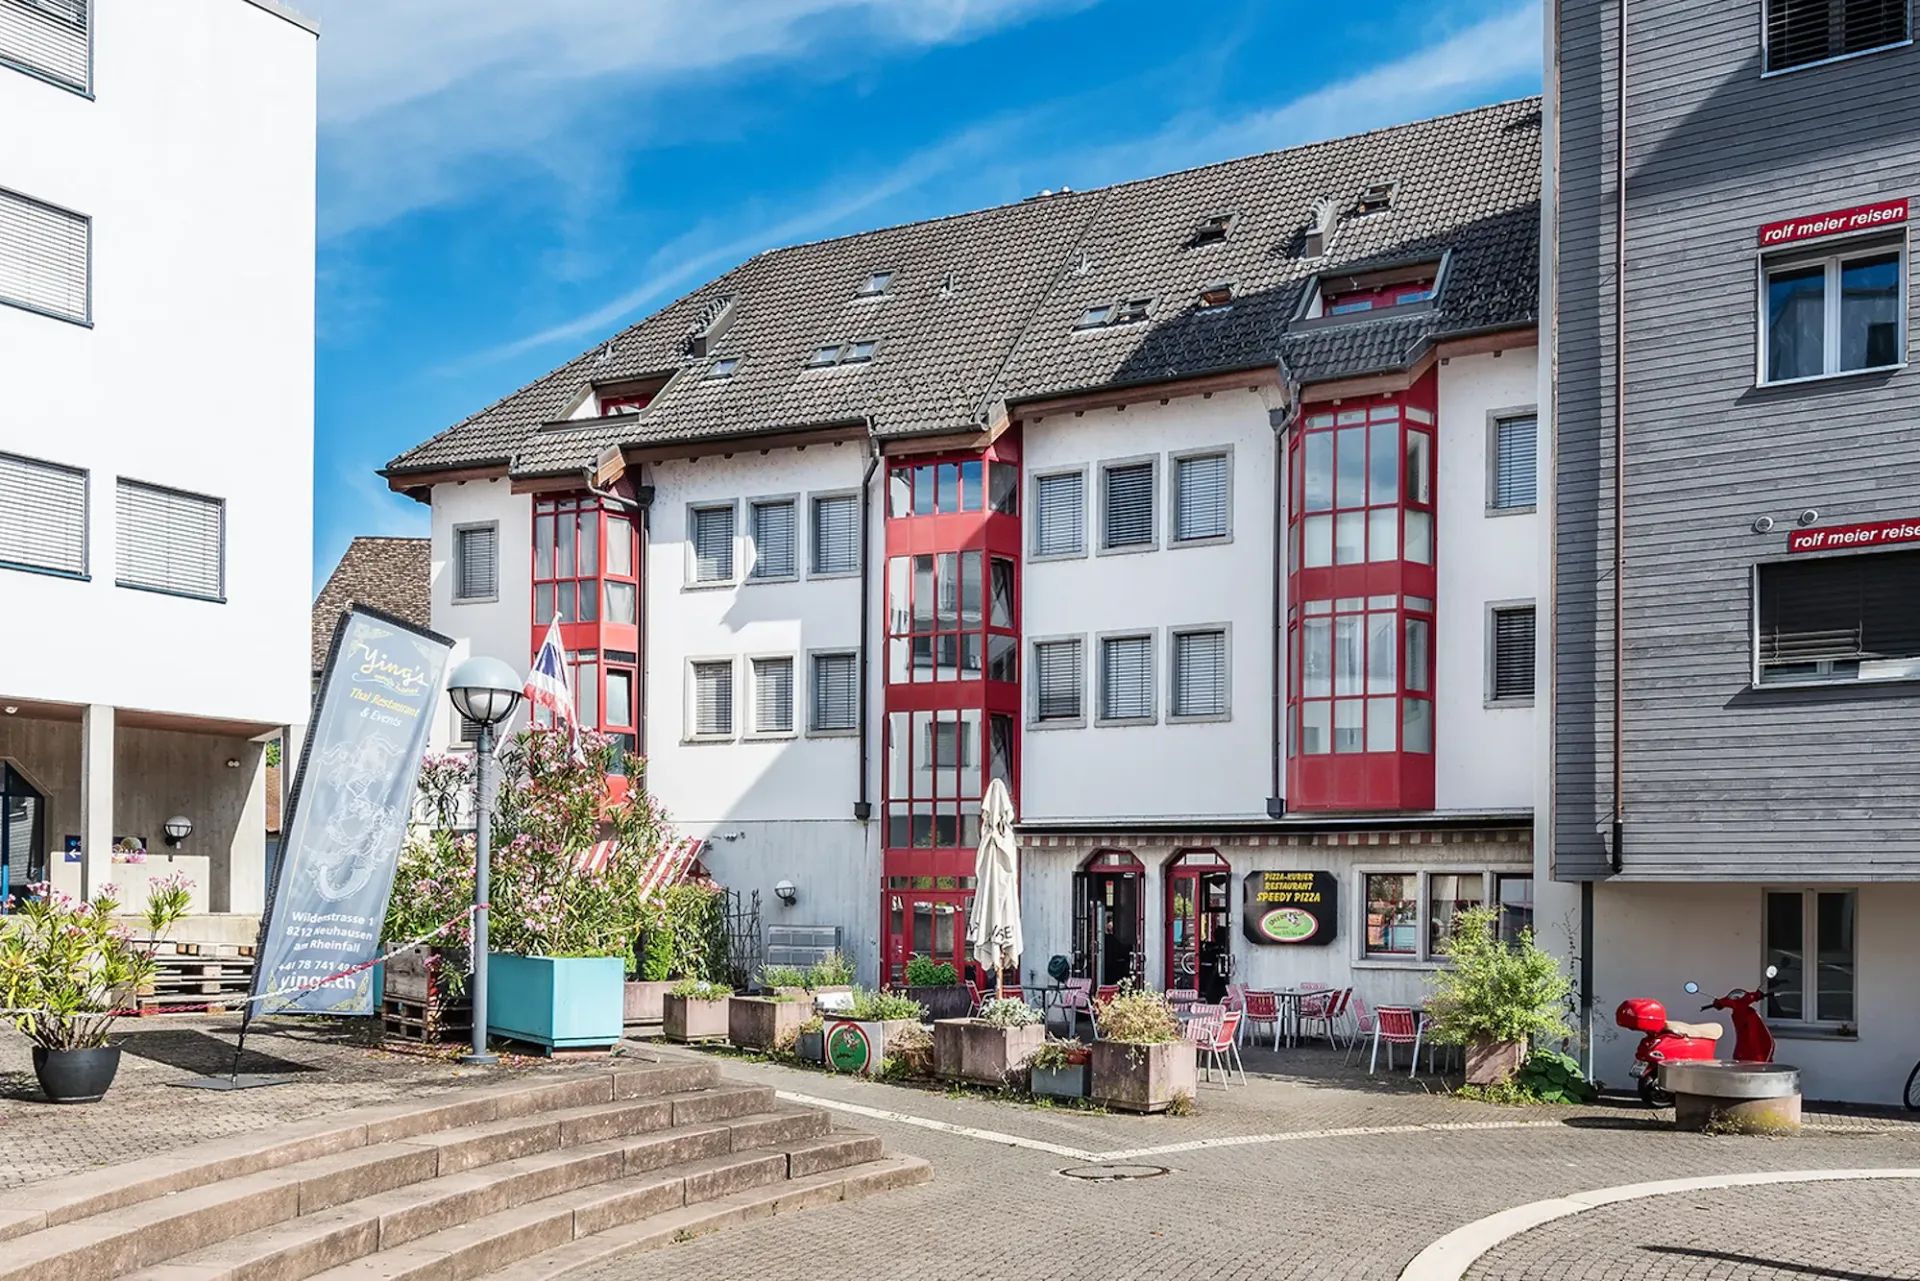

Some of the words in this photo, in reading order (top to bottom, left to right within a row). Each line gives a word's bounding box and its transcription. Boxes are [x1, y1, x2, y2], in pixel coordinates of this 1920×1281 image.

[1764, 224, 1795, 242] rolf
[1797, 216, 1847, 236] meier
[1850, 206, 1904, 226] reisen
[1794, 531, 1826, 548] rolf
[1827, 528, 1879, 545] meier
[370, 710, 403, 727] Events
[1264, 882, 1314, 891] RESTAURANT
[1256, 892, 1293, 902] SPEEDY
[1293, 892, 1321, 902] PIZZA
[368, 917, 375, 926] 1
[286, 926, 313, 937] 8212
[313, 926, 373, 941] Neuhausen
[309, 938, 361, 953] Rheinfall
[298, 960, 312, 970] 78
[314, 960, 334, 971] 741
